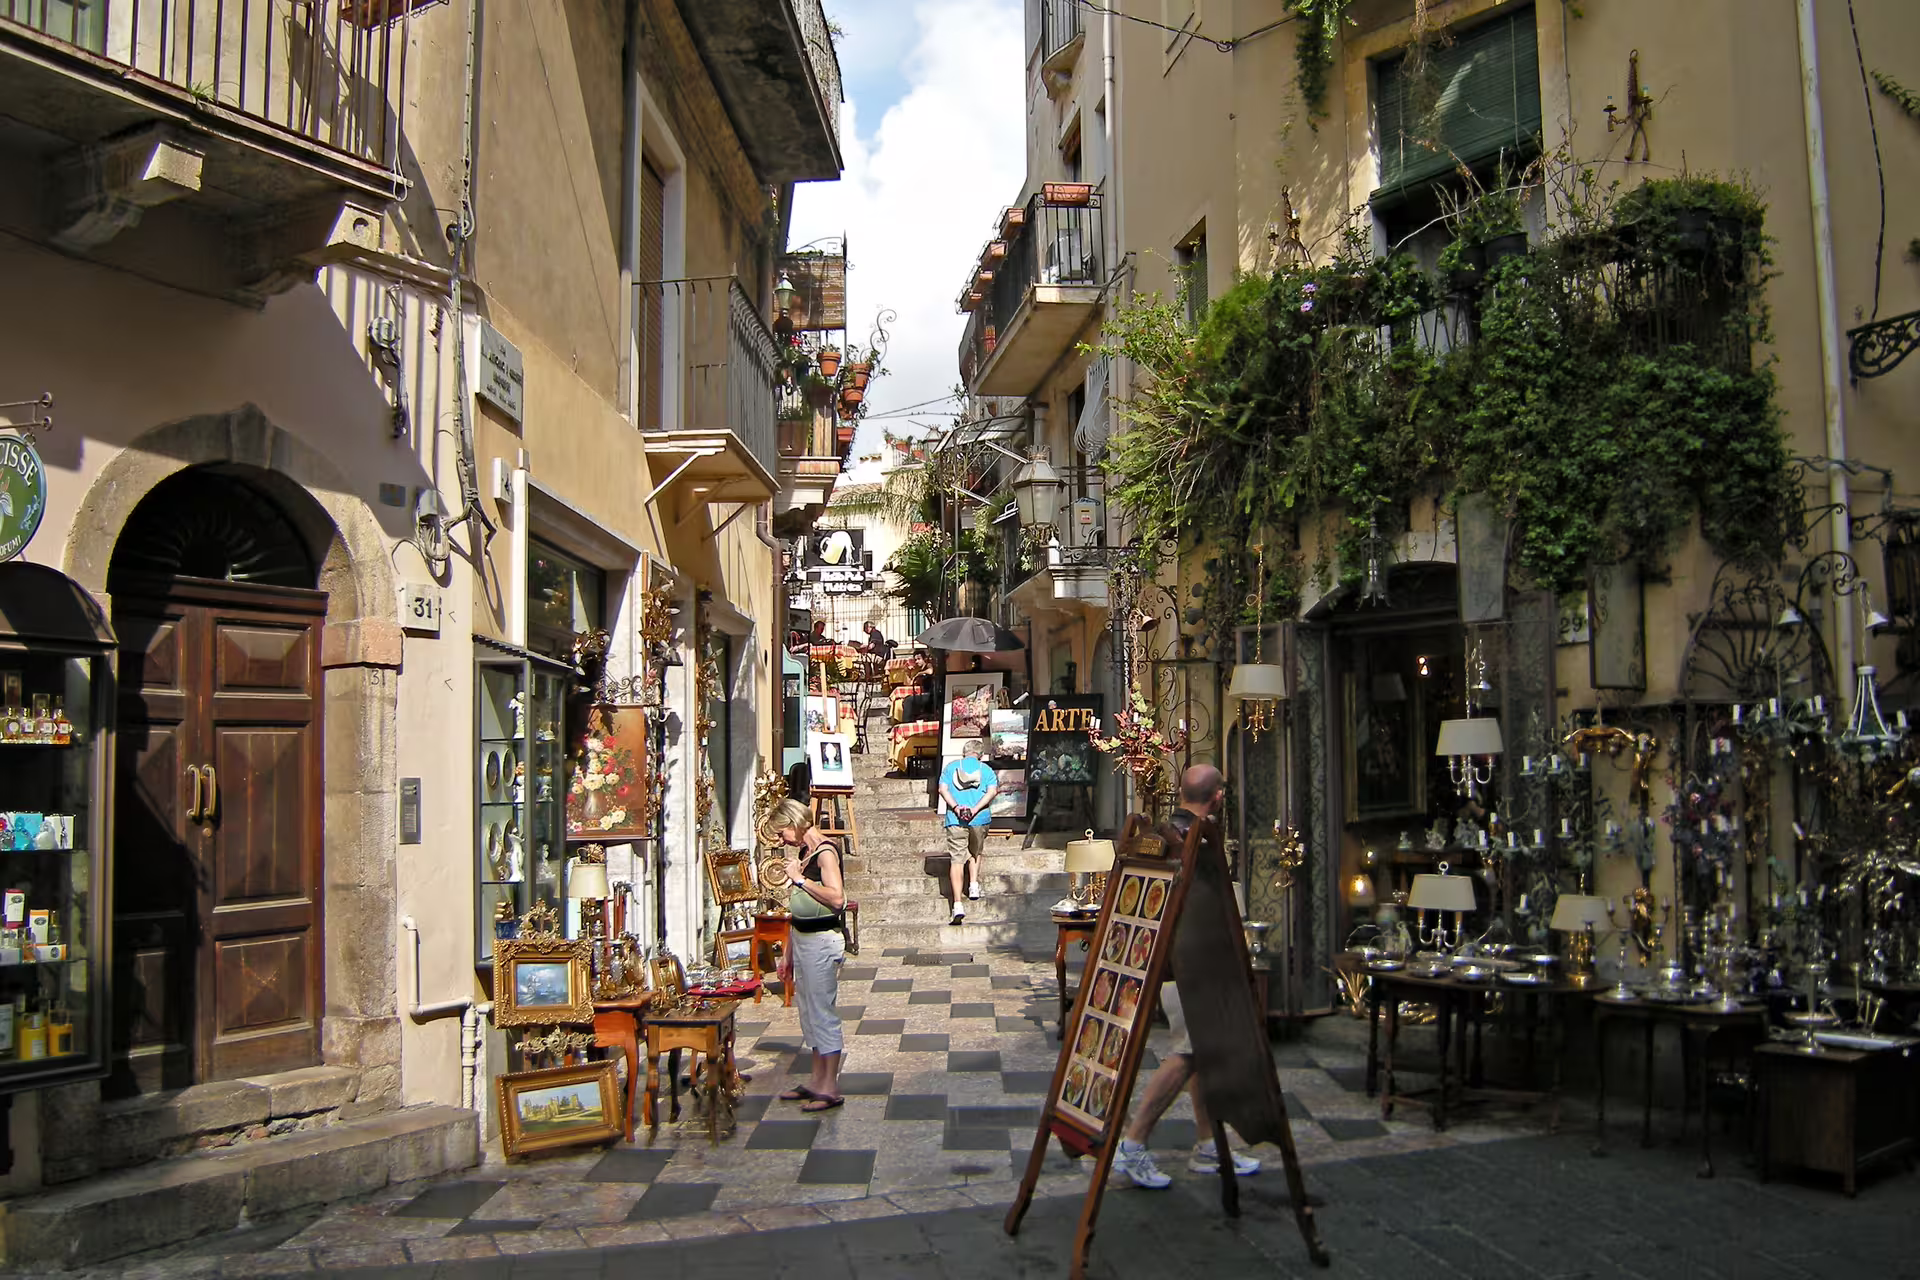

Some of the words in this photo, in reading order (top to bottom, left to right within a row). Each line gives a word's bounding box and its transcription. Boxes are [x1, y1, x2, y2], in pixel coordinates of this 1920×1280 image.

[414, 597, 432, 619] 31
[1560, 617, 1583, 634] 29
[1033, 708, 1094, 731] ARTE
